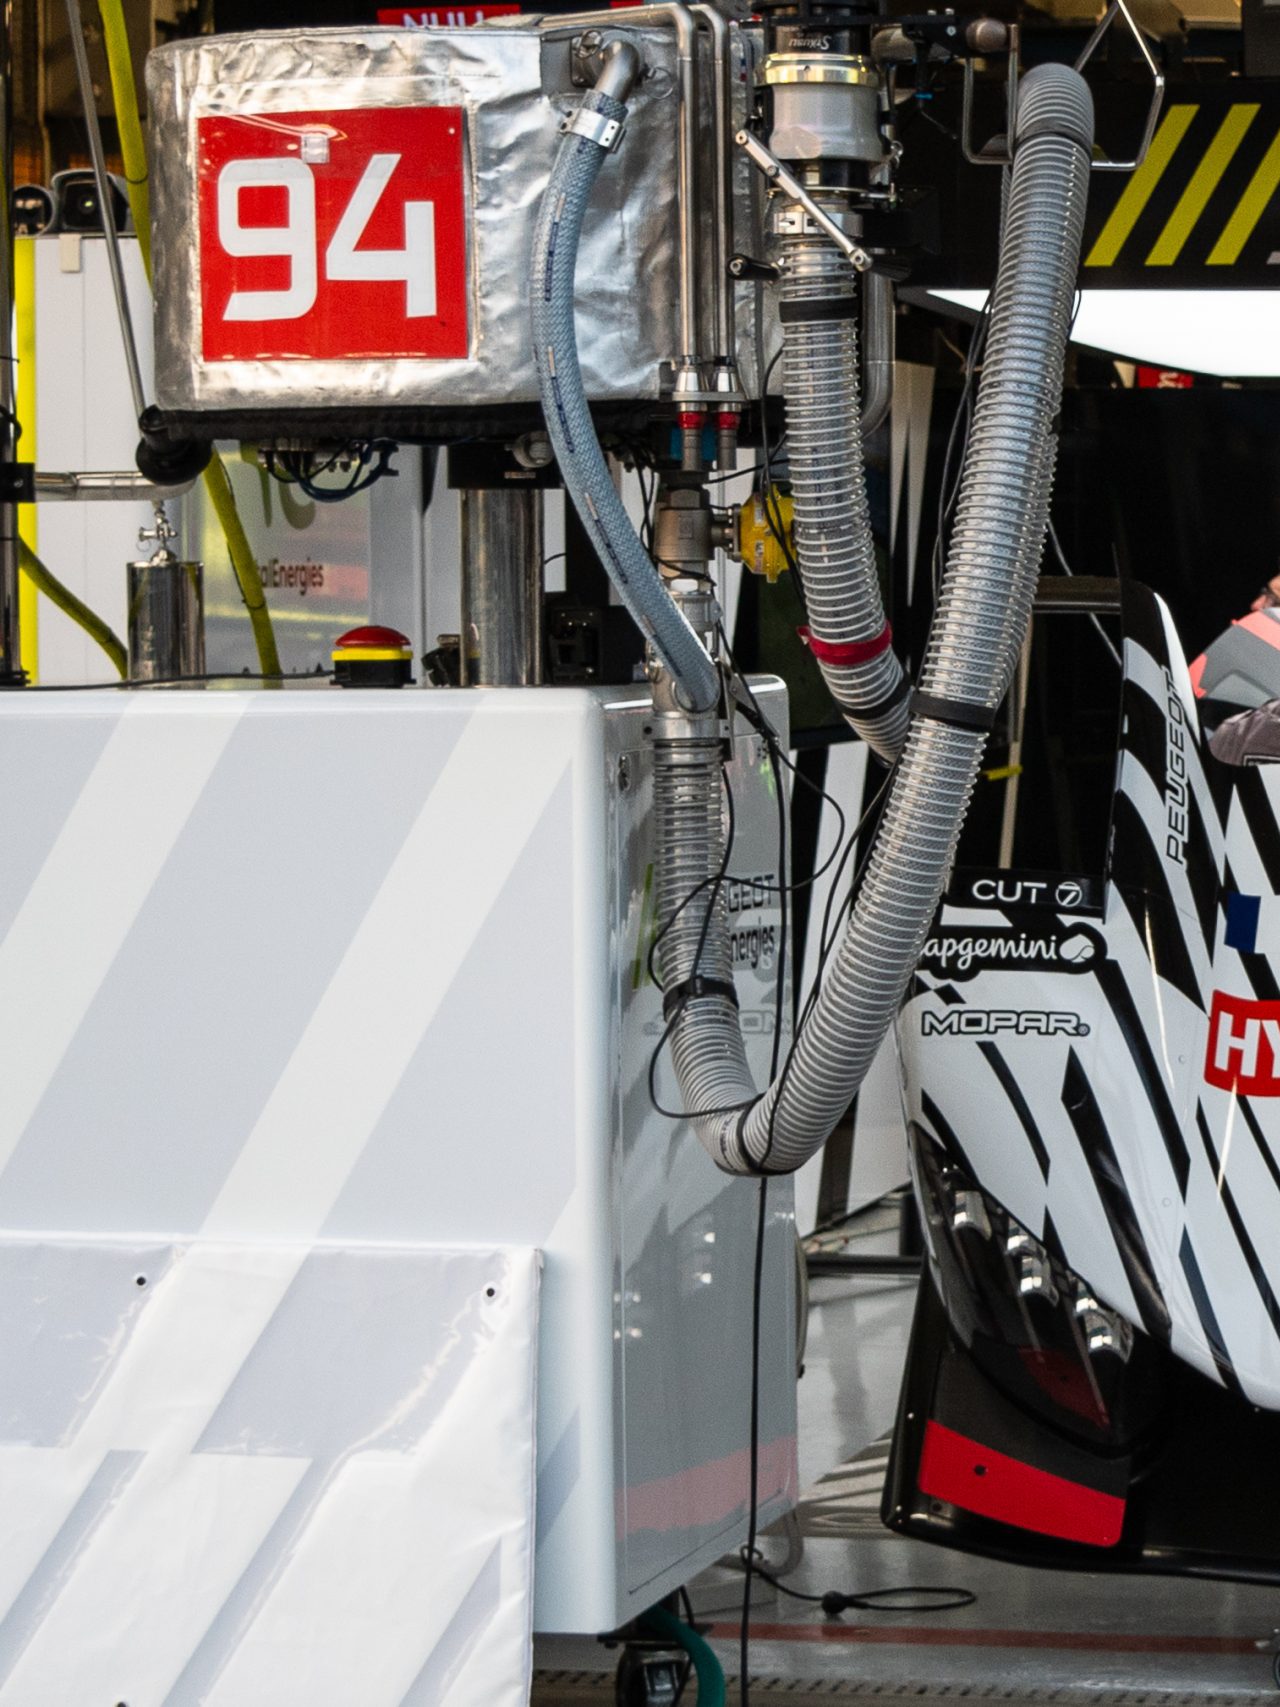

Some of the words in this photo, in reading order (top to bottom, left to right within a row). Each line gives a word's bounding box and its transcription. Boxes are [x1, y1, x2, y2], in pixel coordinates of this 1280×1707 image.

[217, 153, 437, 322] 94
[1165, 671, 1186, 865] PEUGEOT
[972, 879, 1048, 904] CUT
